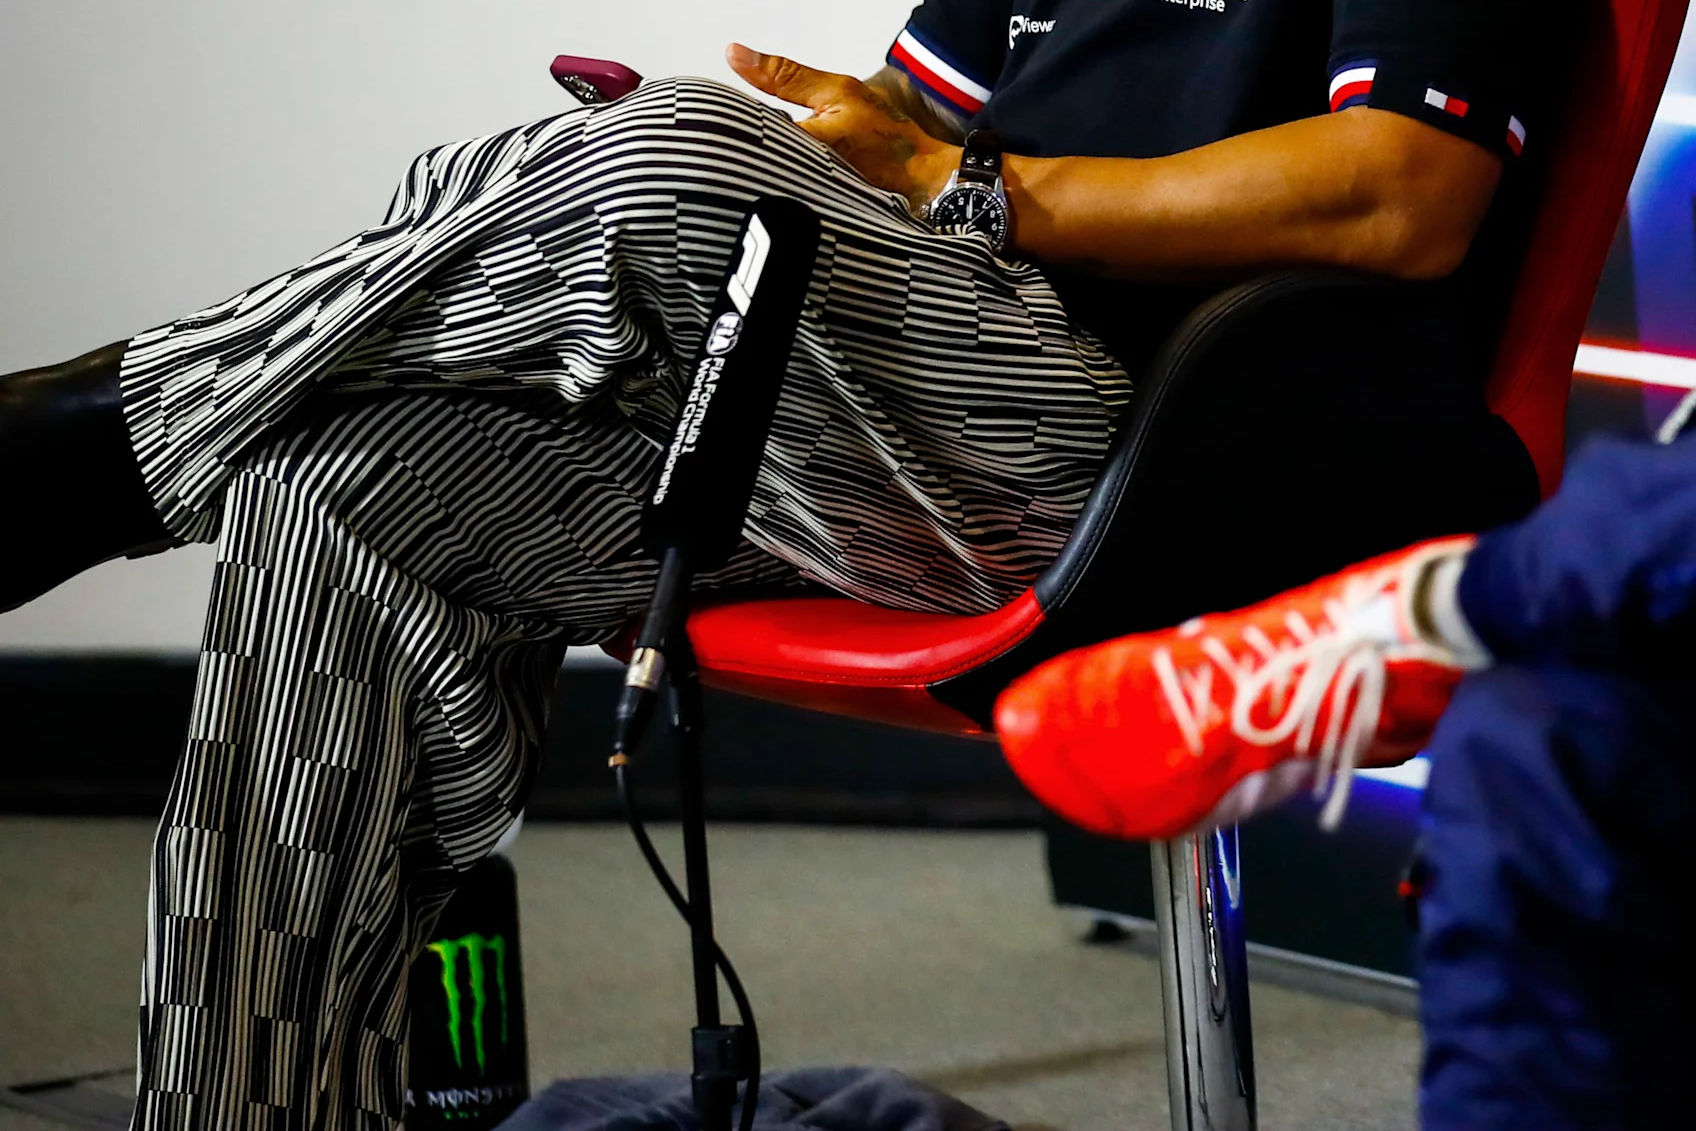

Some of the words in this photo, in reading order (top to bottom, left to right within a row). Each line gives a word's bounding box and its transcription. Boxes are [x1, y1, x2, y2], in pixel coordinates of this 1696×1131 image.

[687, 357, 713, 403] World
[705, 357, 726, 382] FIA
[684, 383, 717, 445] Formula
[652, 403, 697, 506] Championship
[424, 1085, 520, 1110] MONST
